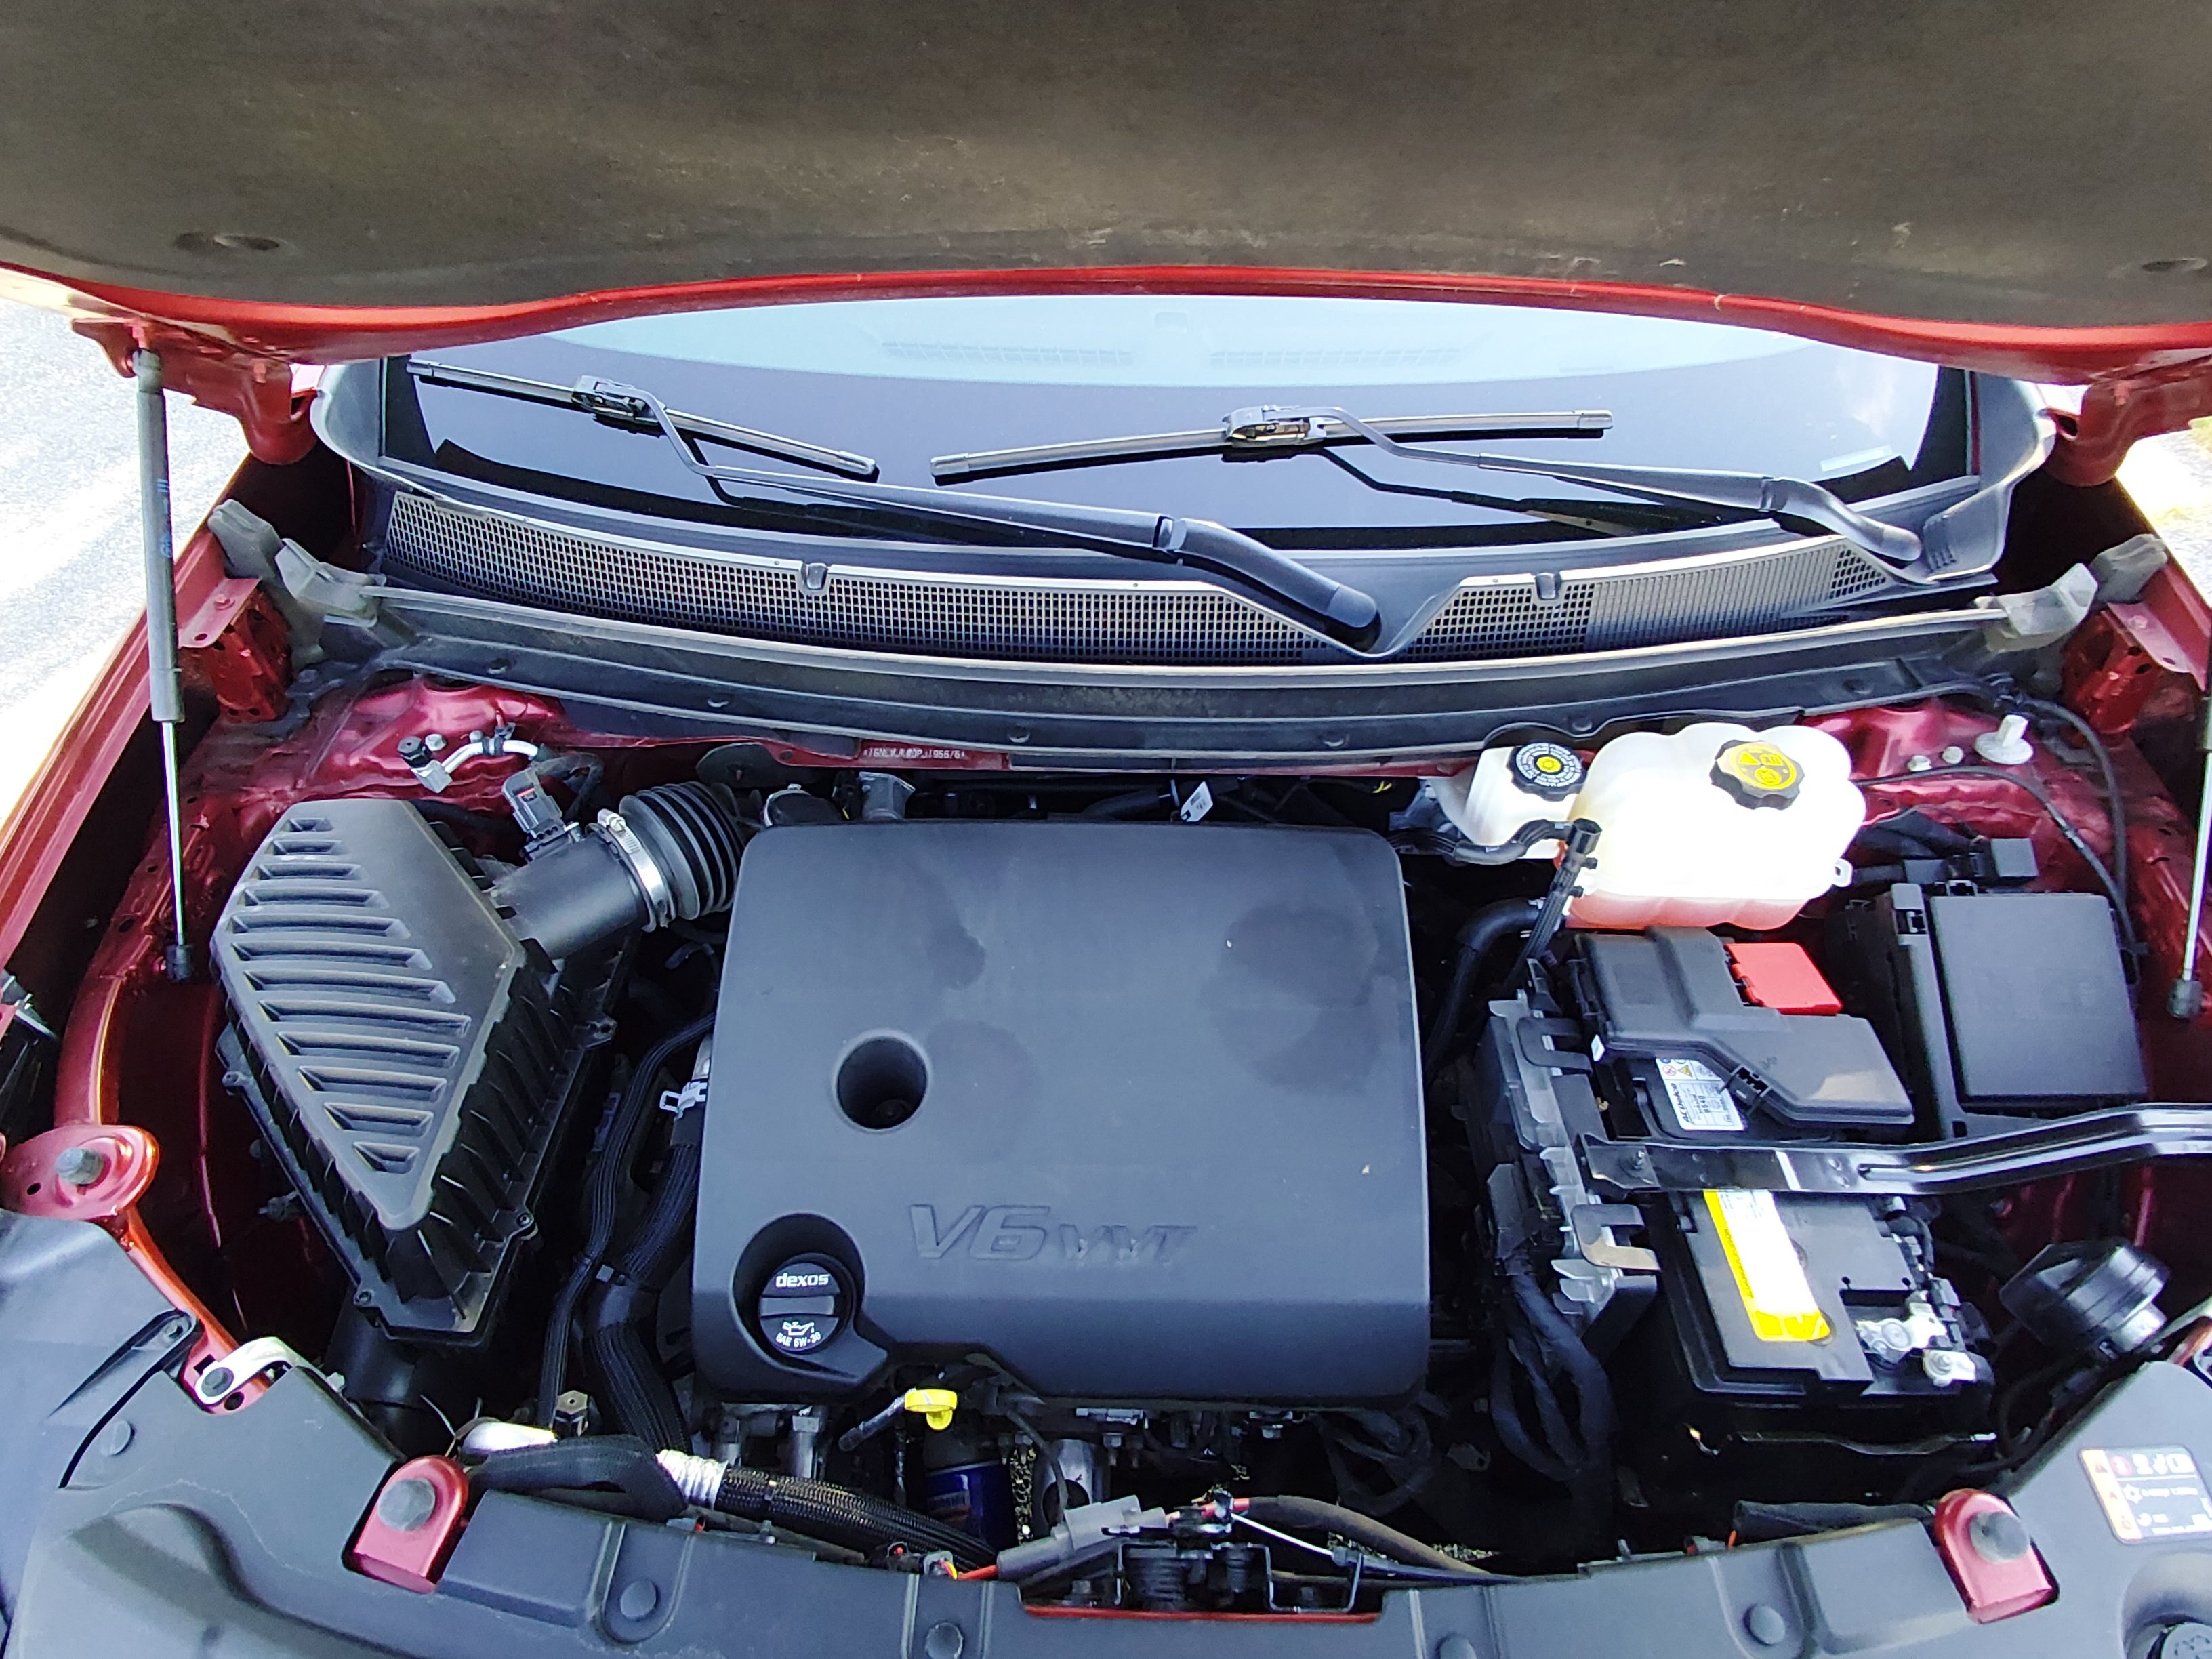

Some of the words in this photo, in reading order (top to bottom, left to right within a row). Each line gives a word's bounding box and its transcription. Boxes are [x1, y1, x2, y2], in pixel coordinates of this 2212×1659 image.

[909, 1203, 1050, 1261] V6
[775, 1273, 831, 1288] dexos
[776, 1332, 792, 1347] SAE
